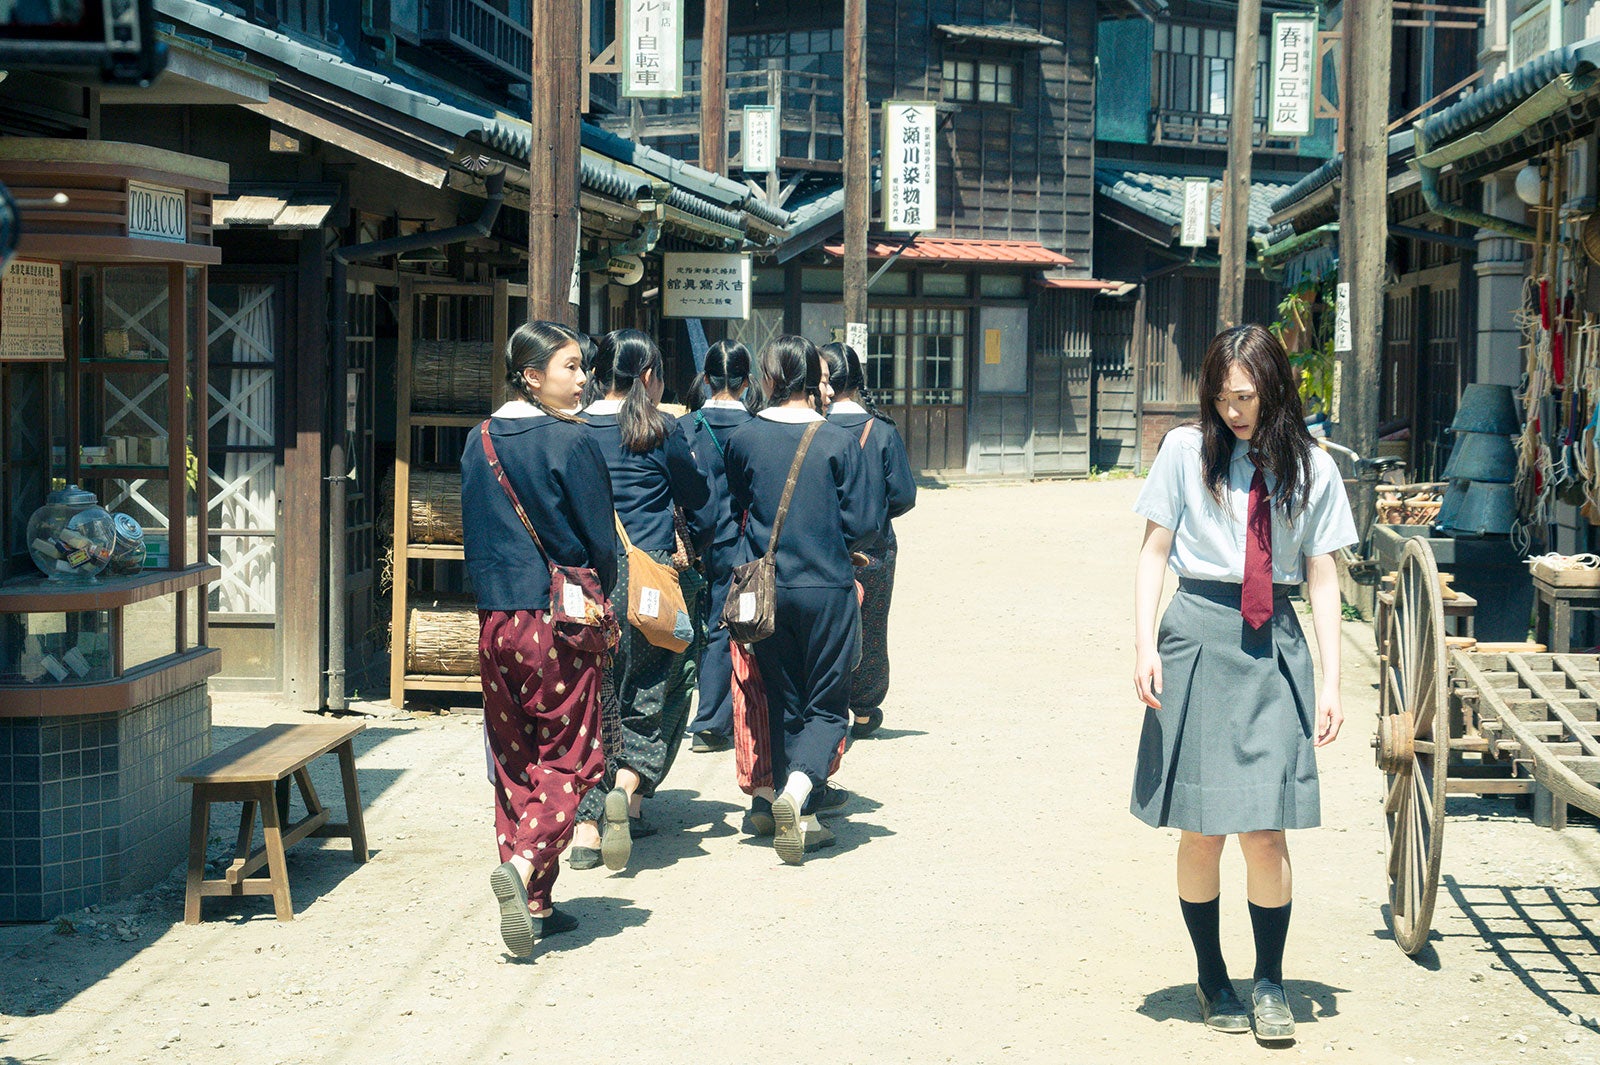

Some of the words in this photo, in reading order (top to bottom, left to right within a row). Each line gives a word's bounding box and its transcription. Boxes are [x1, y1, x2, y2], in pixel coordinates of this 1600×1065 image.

[1276, 27, 1301, 123] 春月豆炭
[130, 189, 183, 235] TOBACCO
